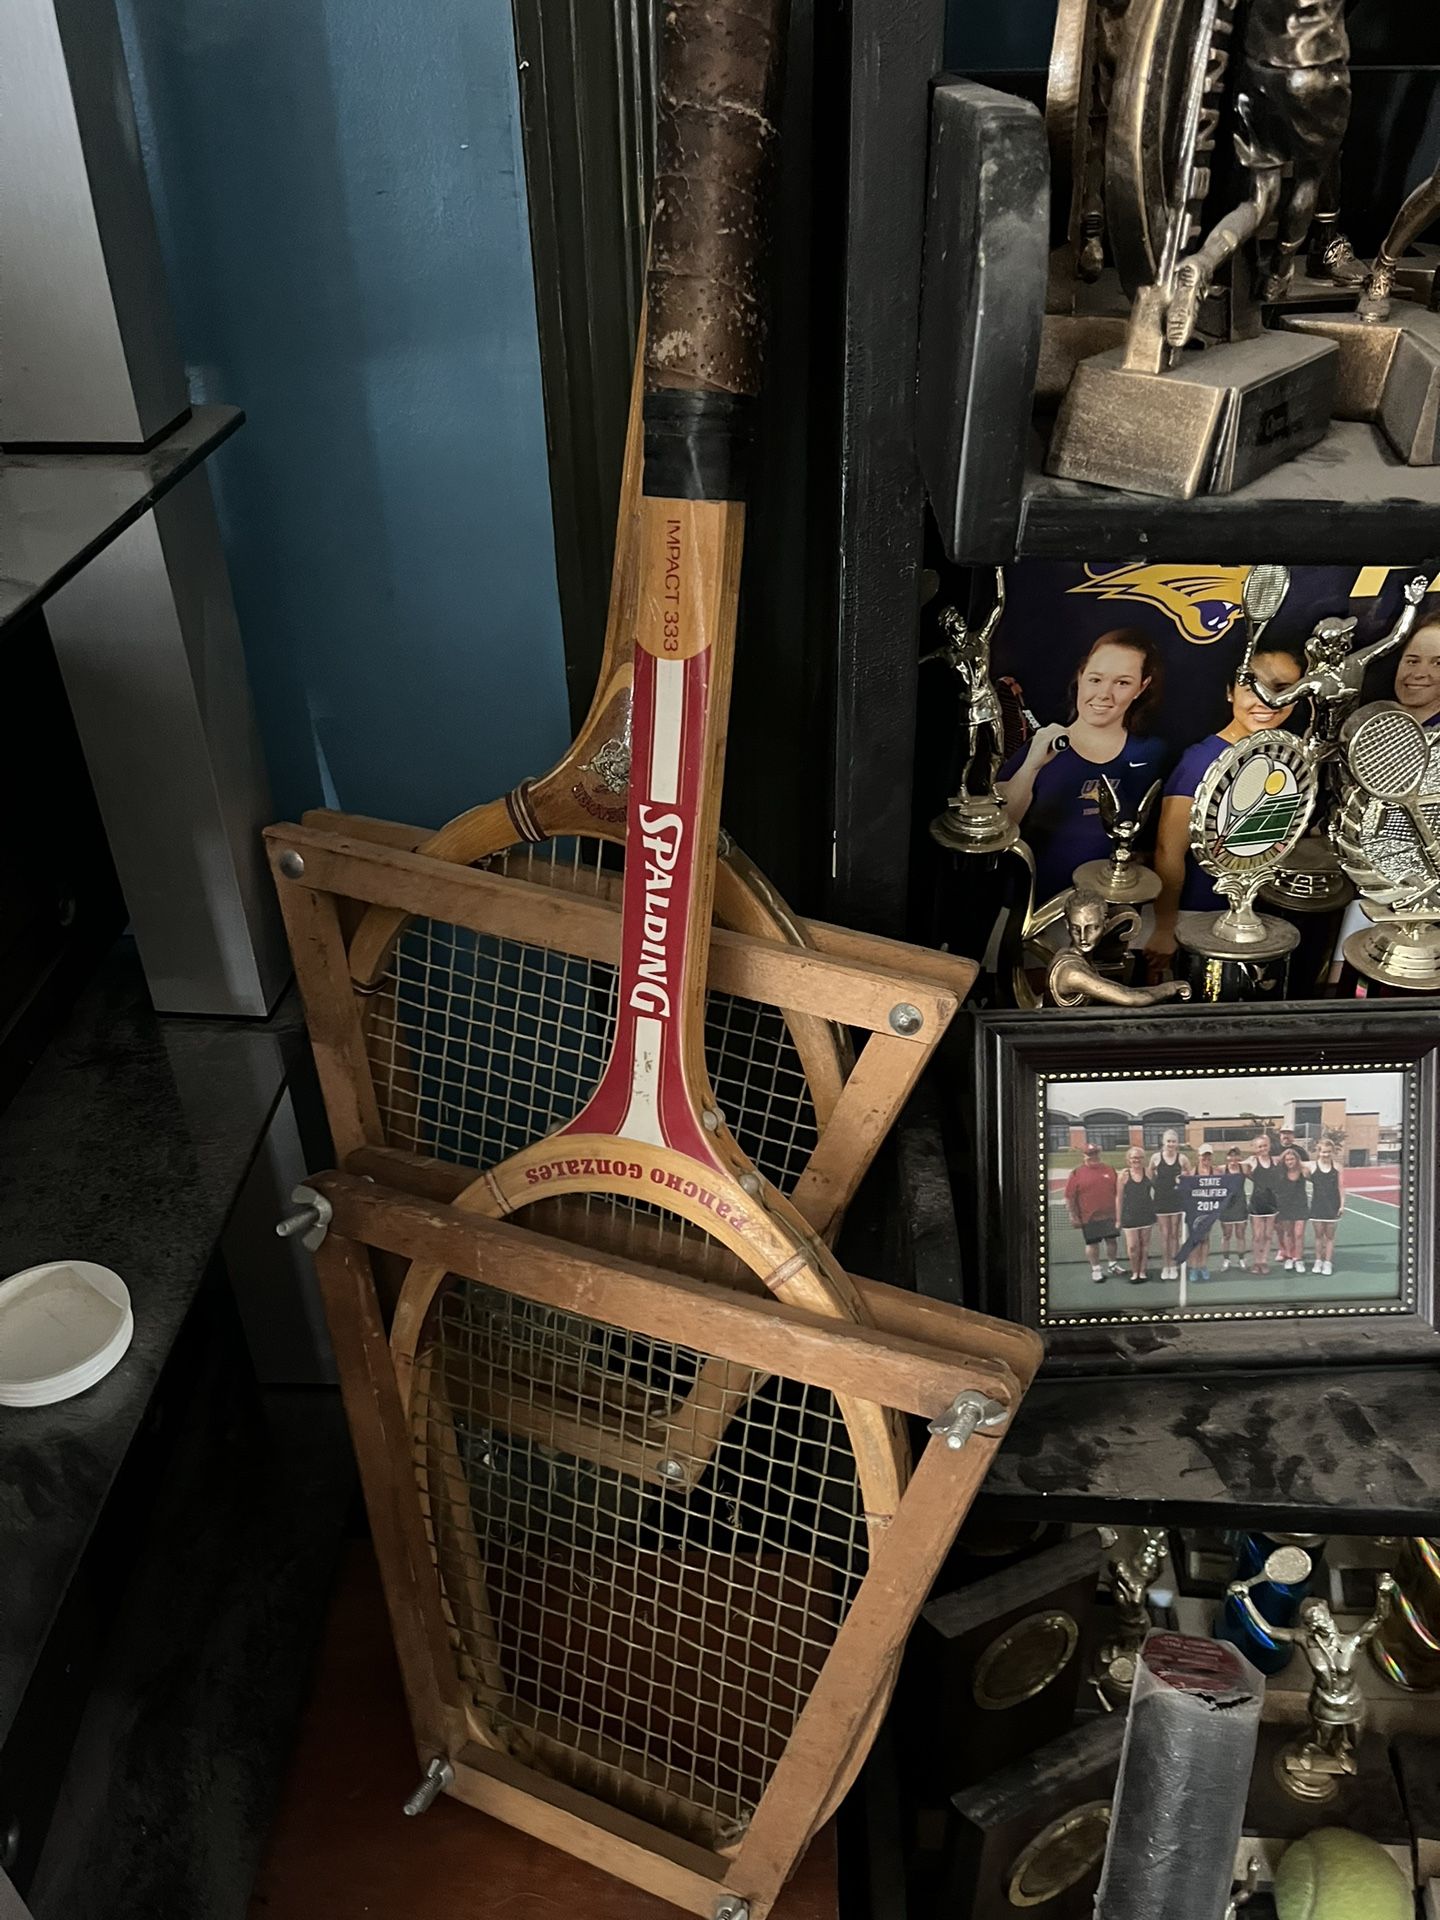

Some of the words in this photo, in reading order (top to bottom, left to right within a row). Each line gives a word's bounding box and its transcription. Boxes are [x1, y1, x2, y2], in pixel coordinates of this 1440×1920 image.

[664, 519, 682, 604] IMPACT
[663, 610, 680, 653] 333
[629, 803, 684, 1018] SPALDING
[1191, 1188, 1228, 1198] QUALIFIER
[1198, 1177, 1222, 1187] STATE
[1197, 1201, 1220, 1211] 2014
